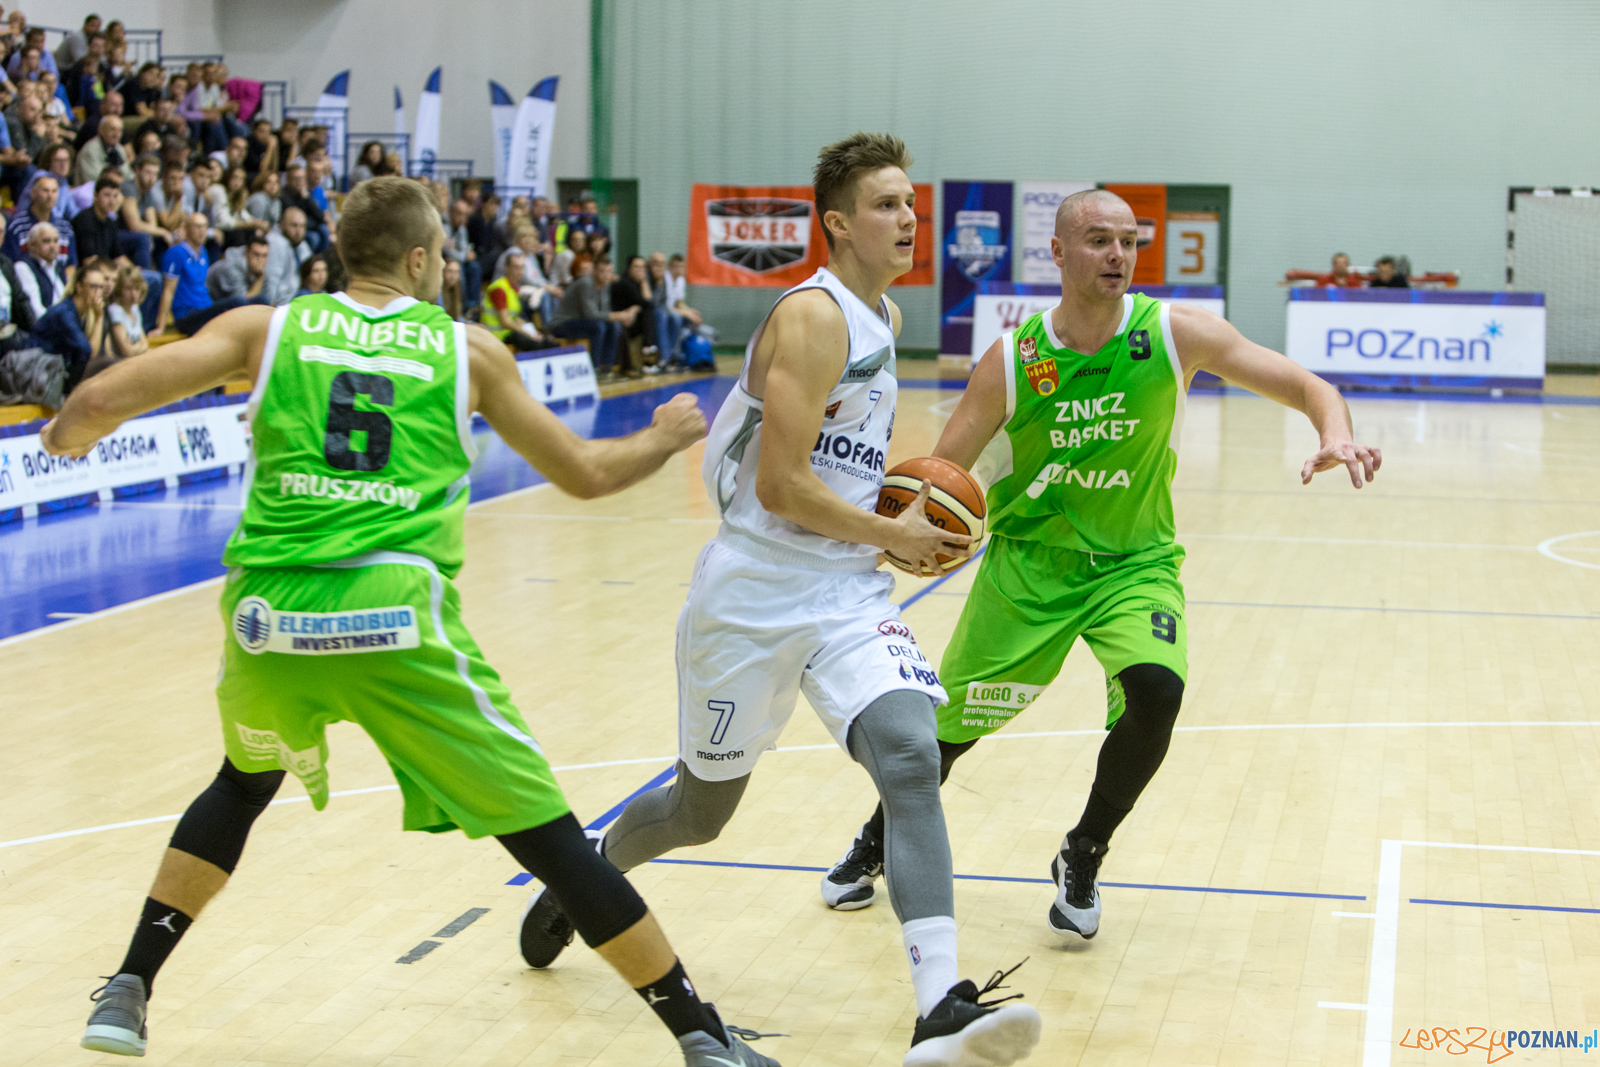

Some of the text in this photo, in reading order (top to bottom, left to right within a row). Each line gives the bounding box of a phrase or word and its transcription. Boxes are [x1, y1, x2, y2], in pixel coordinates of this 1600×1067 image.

[722, 221, 798, 243] JOKER
[1179, 231, 1204, 275] 3
[300, 308, 446, 355] UNIBEN
[1128, 329, 1151, 361] 9
[1326, 328, 1491, 361] POZnan
[324, 371, 394, 472] 6
[1054, 392, 1126, 422] ZNICZ
[97, 434, 159, 463] BIOFARM
[1049, 419, 1140, 448] BASKET
[813, 431, 884, 472] BIOFAR
[810, 455, 834, 469] LSKI
[834, 462, 877, 484] PRODUCENT
[280, 473, 422, 511] PRUSZKÓW
[292, 632, 399, 650] INVESTMENT
[1151, 612, 1177, 645] 9
[972, 687, 1012, 702] LOGO
[708, 699, 735, 745] 7
[963, 706, 1016, 718] profesjonalna
[697, 750, 744, 761] macron
